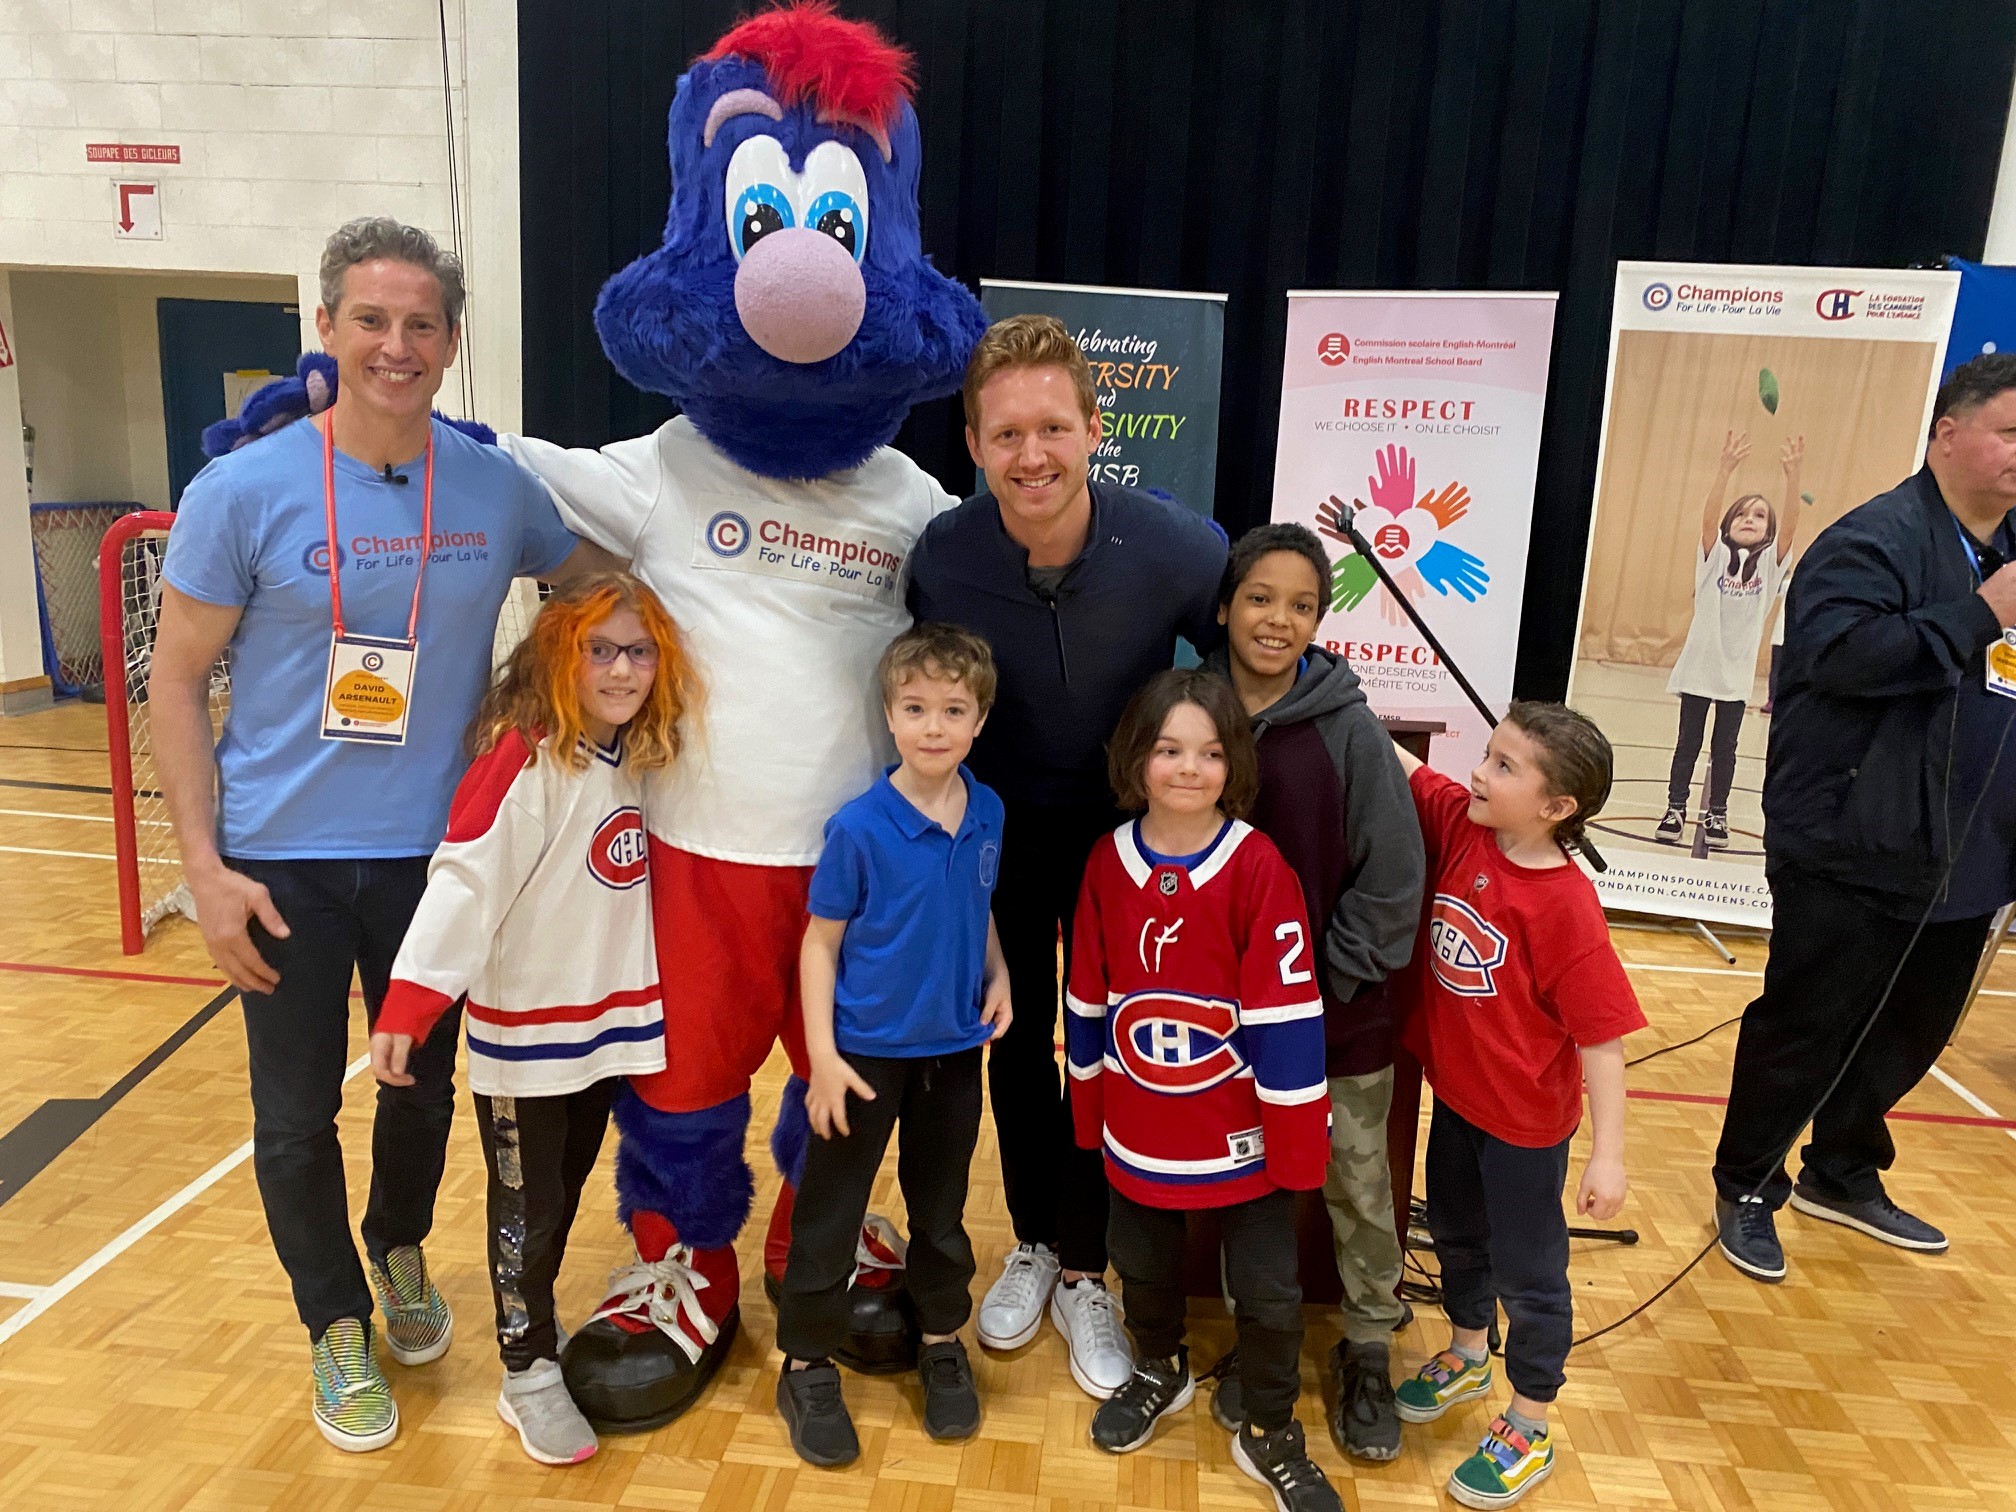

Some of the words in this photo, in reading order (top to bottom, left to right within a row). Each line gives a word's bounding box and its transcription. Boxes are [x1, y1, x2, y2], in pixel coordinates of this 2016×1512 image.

[88, 146, 120, 159] SOUPAPE
[123, 147, 138, 159] DES
[141, 148, 177, 161] GICLEURS
[1677, 284, 1783, 305] Champions
[1676, 302, 1693, 312] For
[1696, 302, 1716, 313] Life
[1722, 303, 1745, 314] Pour
[1748, 305, 1762, 315] La
[1766, 305, 1781, 315] Vie
[1069, 328, 1157, 363] lebrating
[1354, 338, 1407, 349] Commission
[1408, 340, 1441, 350] scolaire
[1442, 340, 1517, 351] English-Montréal
[1352, 355, 1383, 367] English
[1385, 356, 1423, 366] Montreal
[1425, 356, 1455, 366] School
[1457, 357, 1483, 367] Board
[1088, 361, 1179, 390] RSITY
[1096, 388, 1116, 407] nd
[1343, 398, 1475, 421] RESPECT
[1100, 411, 1186, 440] SIVITY
[1314, 421, 1335, 431] WE
[1335, 421, 1387, 432] CHOOSE
[1387, 422, 1397, 432] IT
[1415, 423, 1436, 434] ON
[1436, 424, 1451, 434] LE
[1453, 424, 1501, 436] CHOISIT
[1096, 438, 1122, 457] the
[351, 529, 487, 556] Champions
[759, 519, 900, 572] Champions
[356, 558, 380, 571] For
[386, 554, 413, 568] Life
[456, 549, 471, 562] La
[473, 549, 489, 561] Vie
[758, 546, 785, 564] For
[791, 553, 821, 571] Life
[829, 561, 862, 580] Pour
[866, 570, 883, 586] La
[1377, 666, 1436, 680] DESERVES
[1438, 670, 1449, 680] IT
[353, 683, 385, 693] DAVID
[1405, 682, 1437, 693] TOUS
[338, 693, 397, 705] ARSENAULT
[1602, 868, 1770, 895] HAMPIONSPOURLAVIE.CA
[1274, 920, 1312, 985] 2
